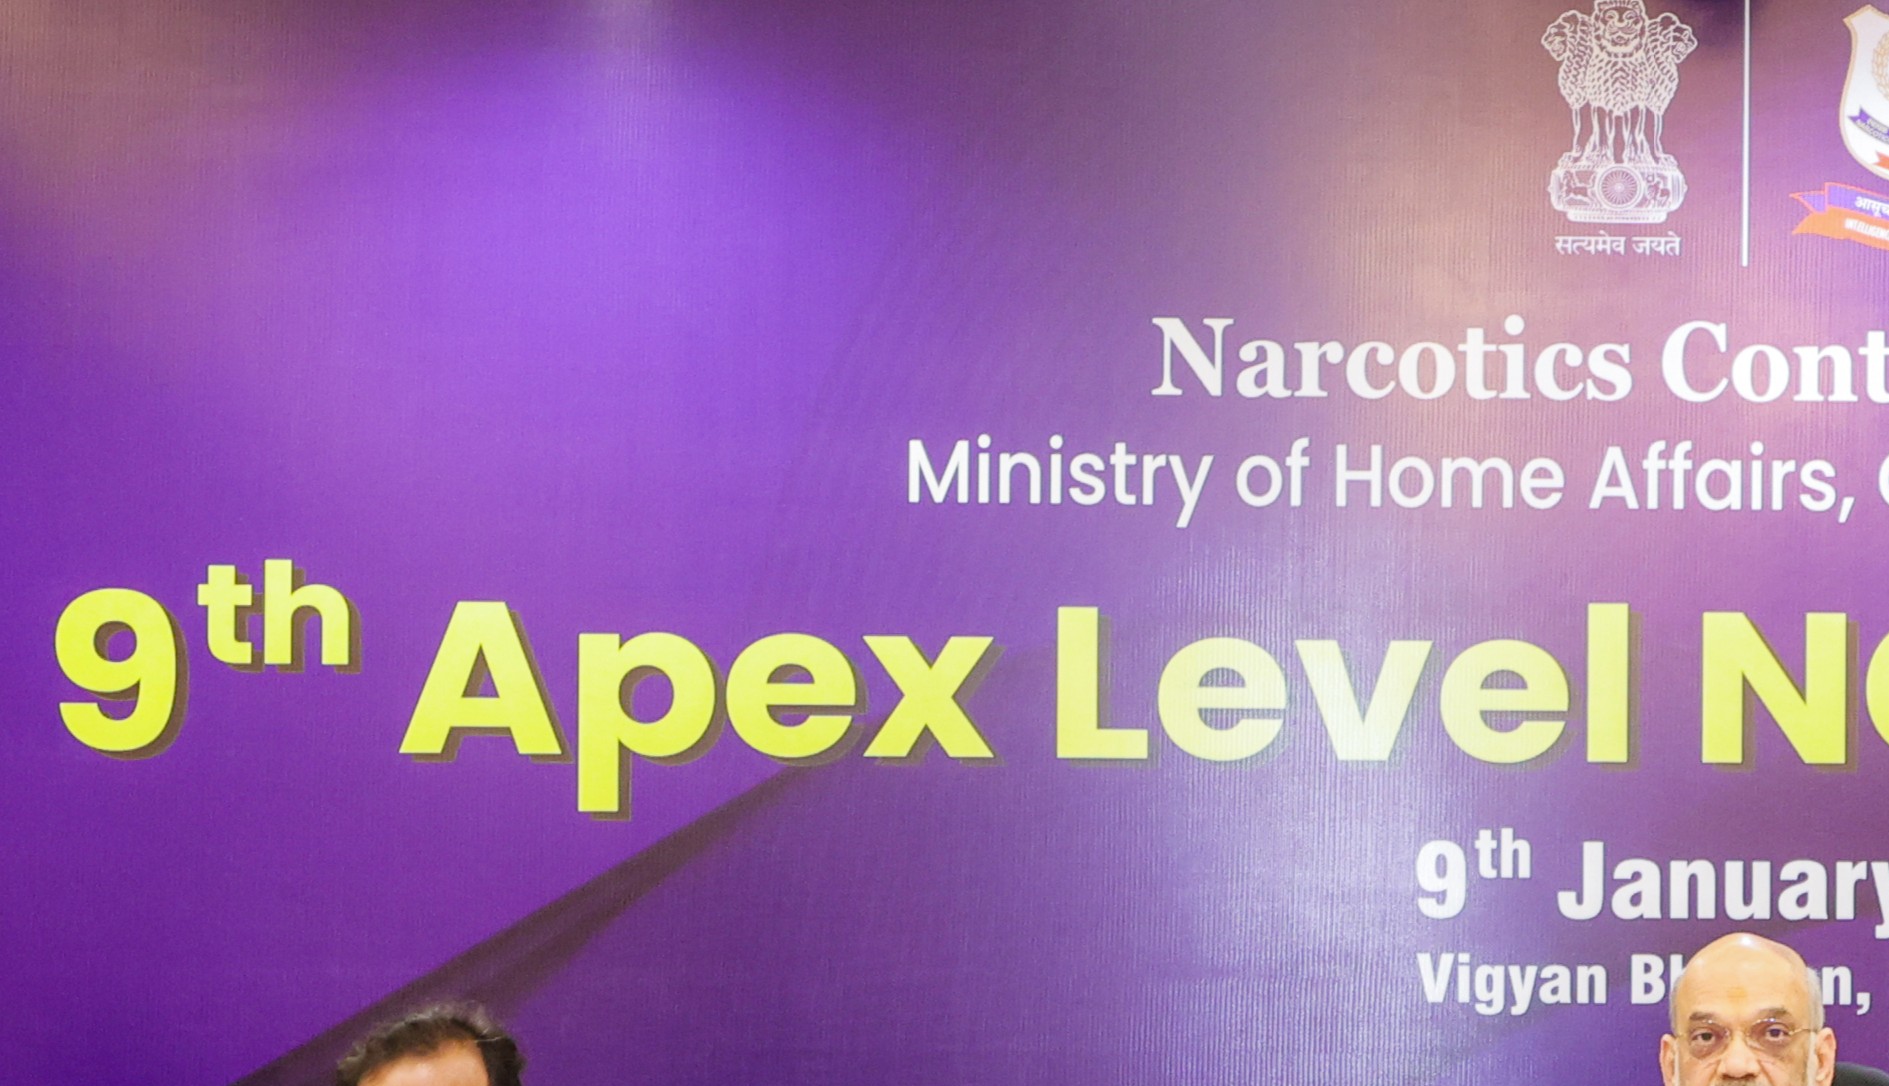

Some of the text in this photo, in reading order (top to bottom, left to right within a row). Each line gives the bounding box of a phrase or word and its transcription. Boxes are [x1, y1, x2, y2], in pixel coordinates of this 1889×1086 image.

[1554, 229, 1682, 256] सत्यमेव जयते
[1152, 314, 1633, 402] Narcotics
[908, 434, 1213, 528] Ministry
[1236, 437, 1310, 507] of
[1336, 444, 1565, 510] Home
[1589, 440, 1855, 523] Affairs,
[55, 559, 350, 753] 9th
[400, 601, 993, 813] Apex
[1057, 603, 1630, 763] Level
[1415, 828, 1531, 920] 9th
[1415, 951, 1606, 1016] Vigyan
